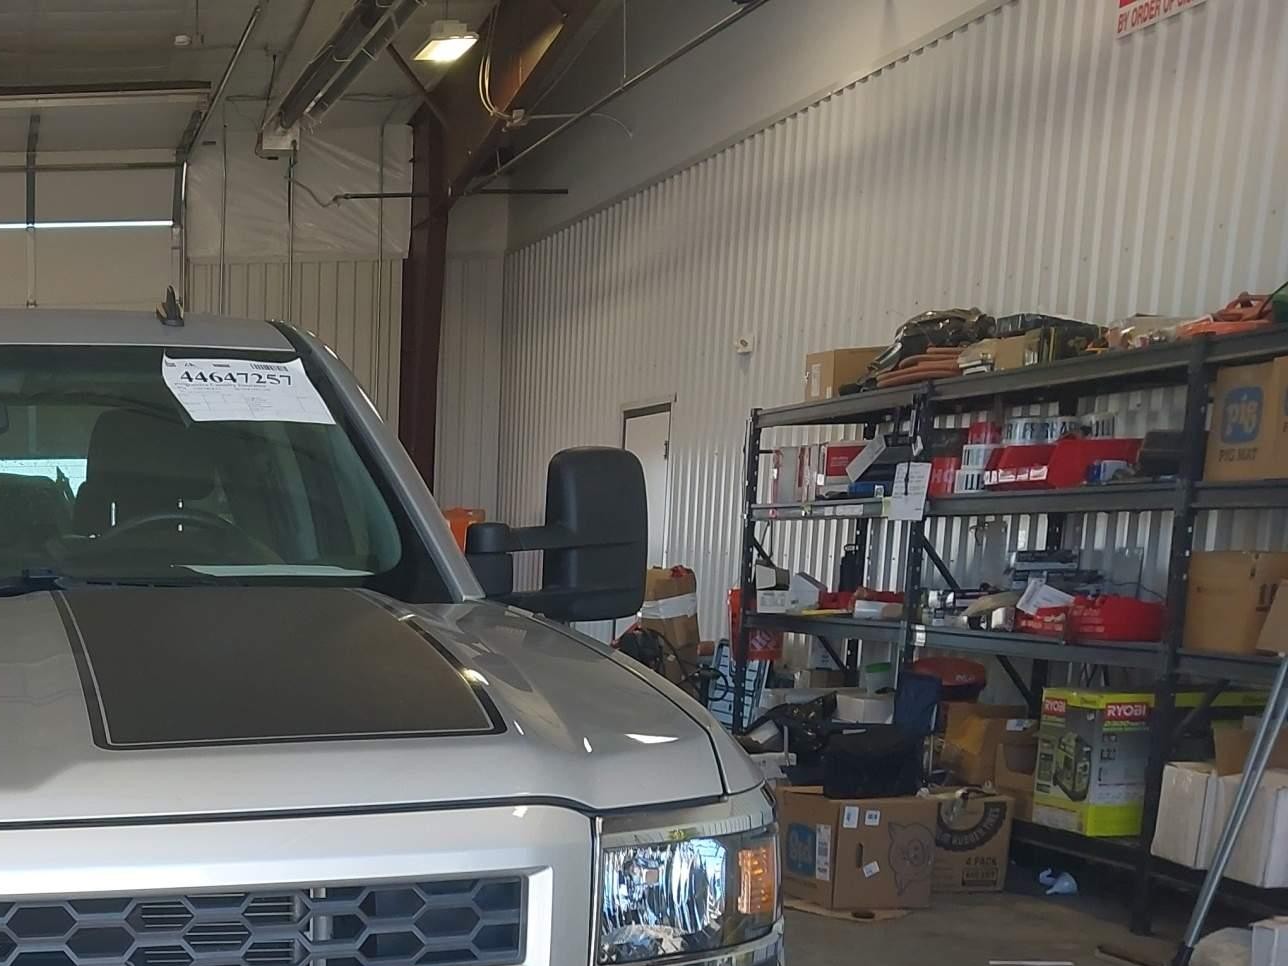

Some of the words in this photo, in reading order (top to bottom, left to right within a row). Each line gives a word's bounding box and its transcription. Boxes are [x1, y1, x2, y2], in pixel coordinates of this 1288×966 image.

[1117, 11, 1130, 33] BY
[1131, 0, 1161, 27] ORDER
[180, 370, 292, 386] 44647257
[1043, 699, 1066, 713] RYOBI
[1106, 704, 1146, 717] RYOBI
